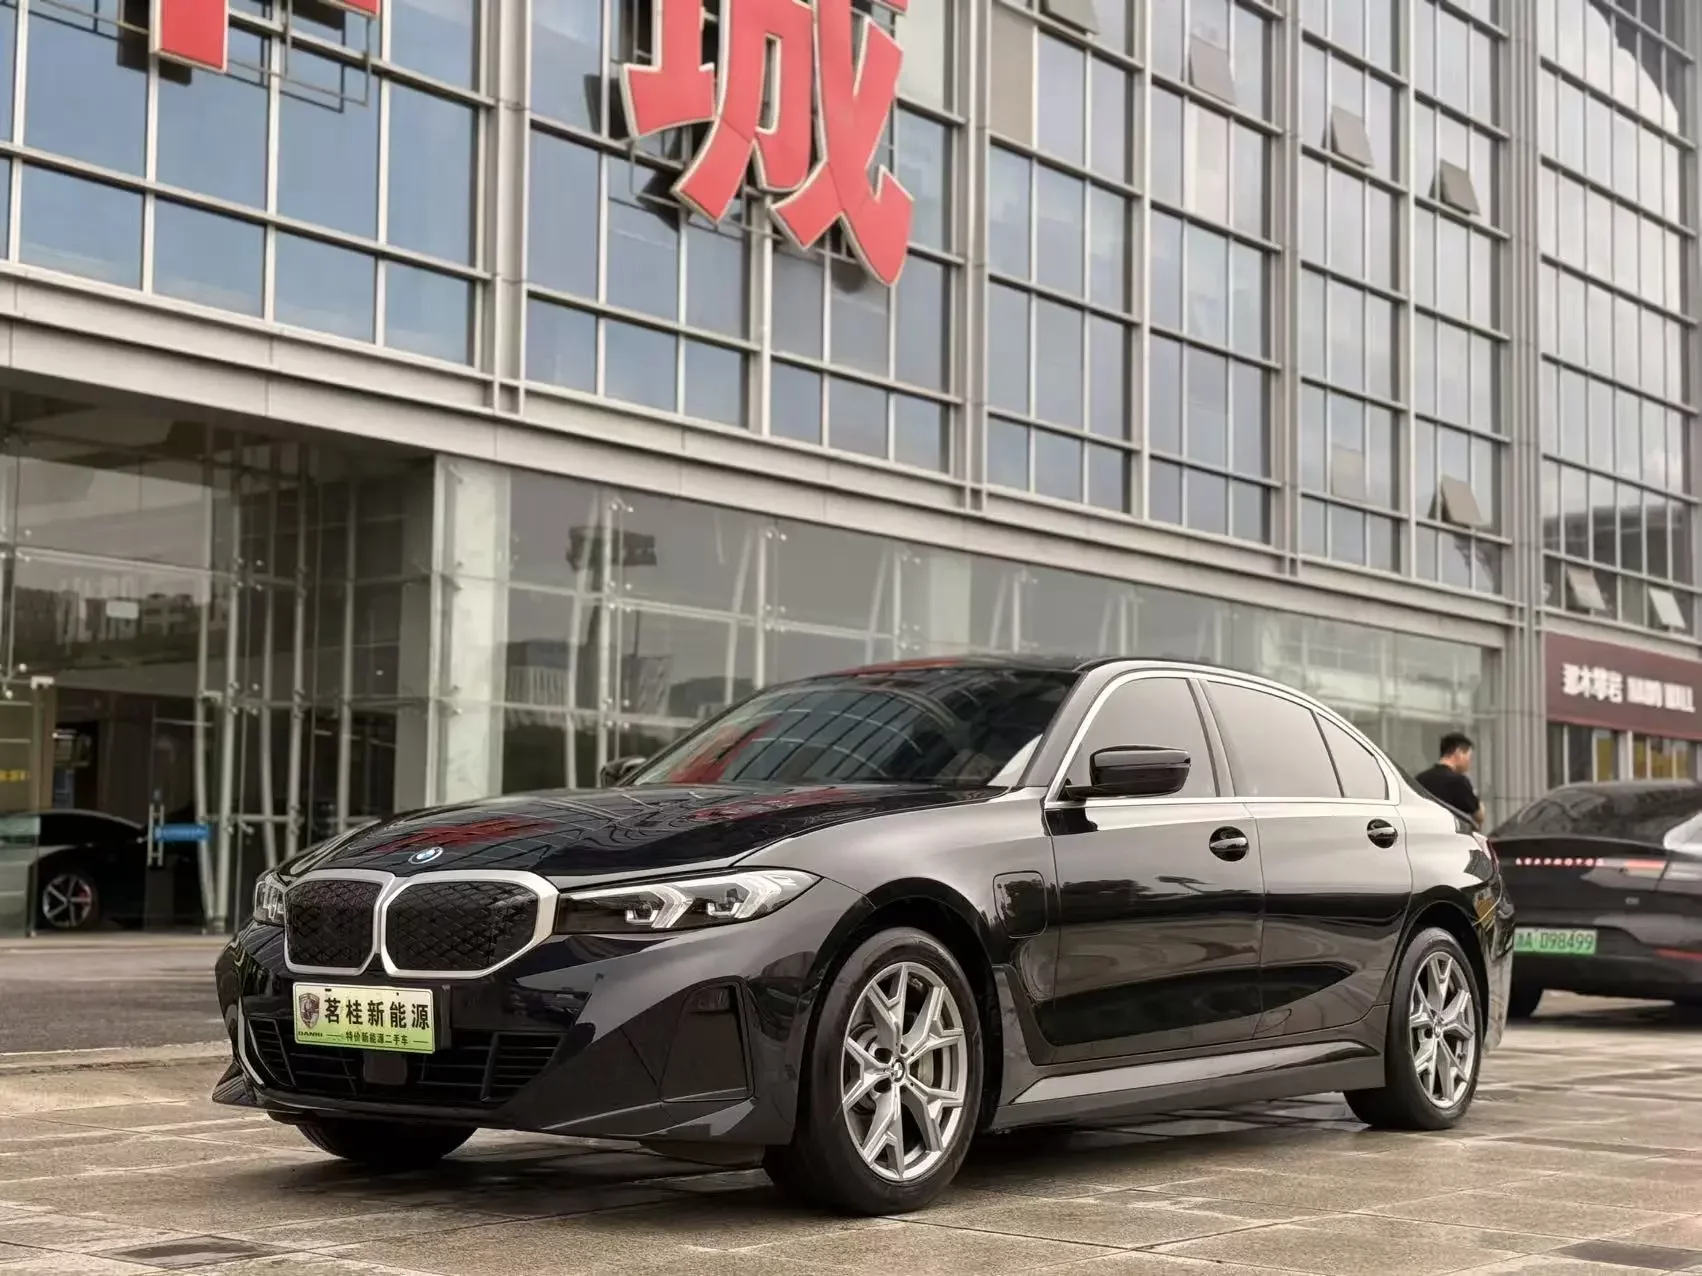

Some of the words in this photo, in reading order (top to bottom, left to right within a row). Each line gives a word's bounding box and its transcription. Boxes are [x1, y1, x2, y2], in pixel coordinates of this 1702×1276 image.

[324, 997, 430, 1030] 茗桂新能源
[345, 1031, 409, 1047] 特价新能源二手车
